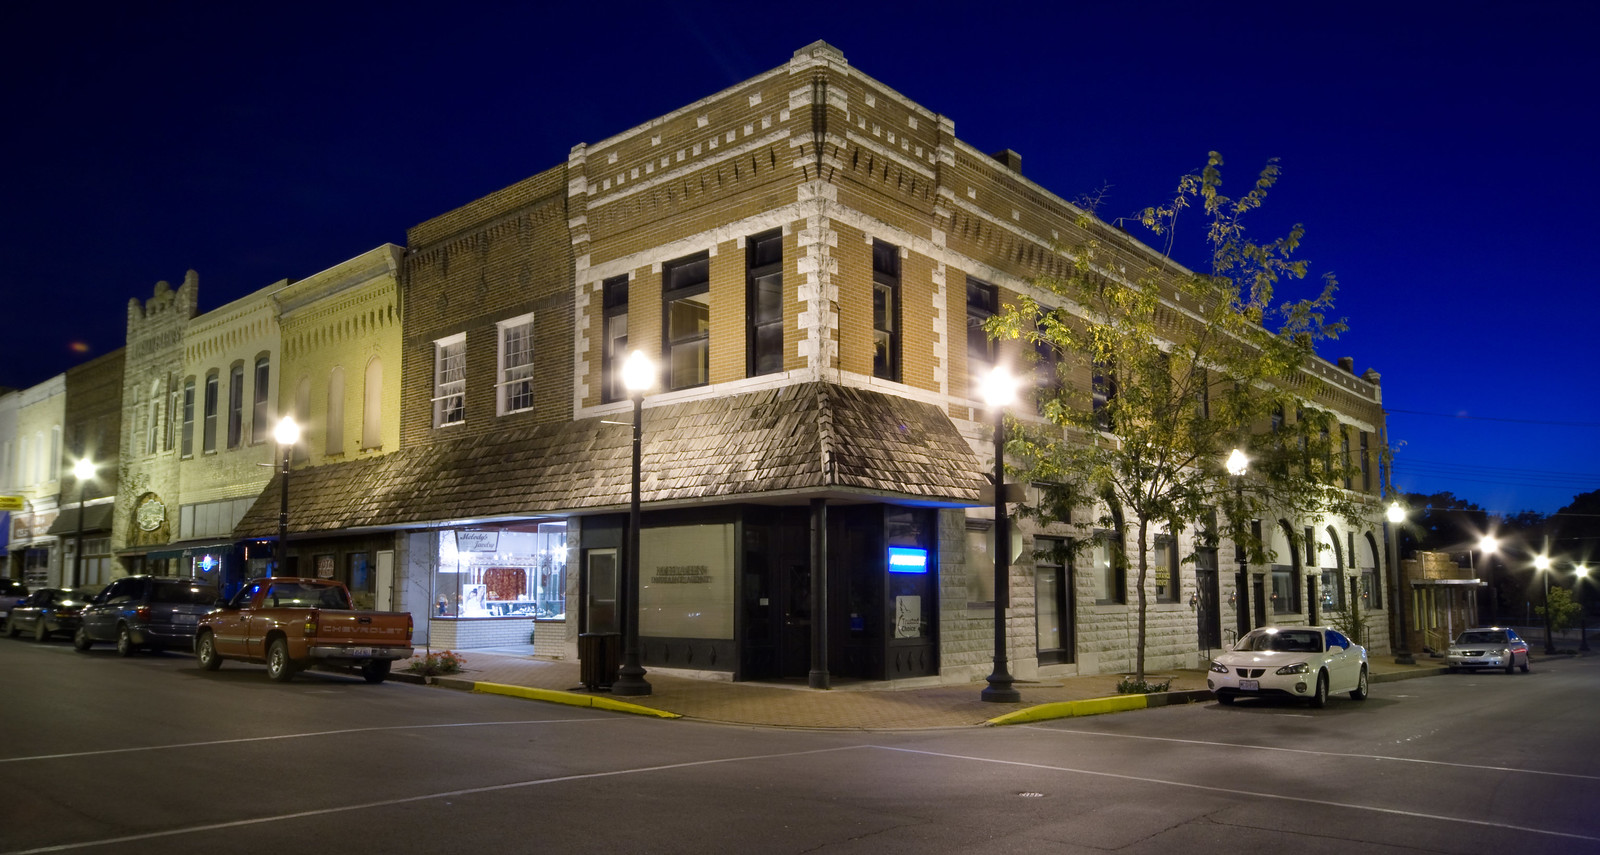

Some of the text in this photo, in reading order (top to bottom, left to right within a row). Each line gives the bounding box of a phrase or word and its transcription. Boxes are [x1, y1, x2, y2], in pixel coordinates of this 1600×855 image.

[460, 533, 488, 542] Melody's
[902, 617, 919, 625] Trusted
[323, 625, 404, 634] CHEVROLET
